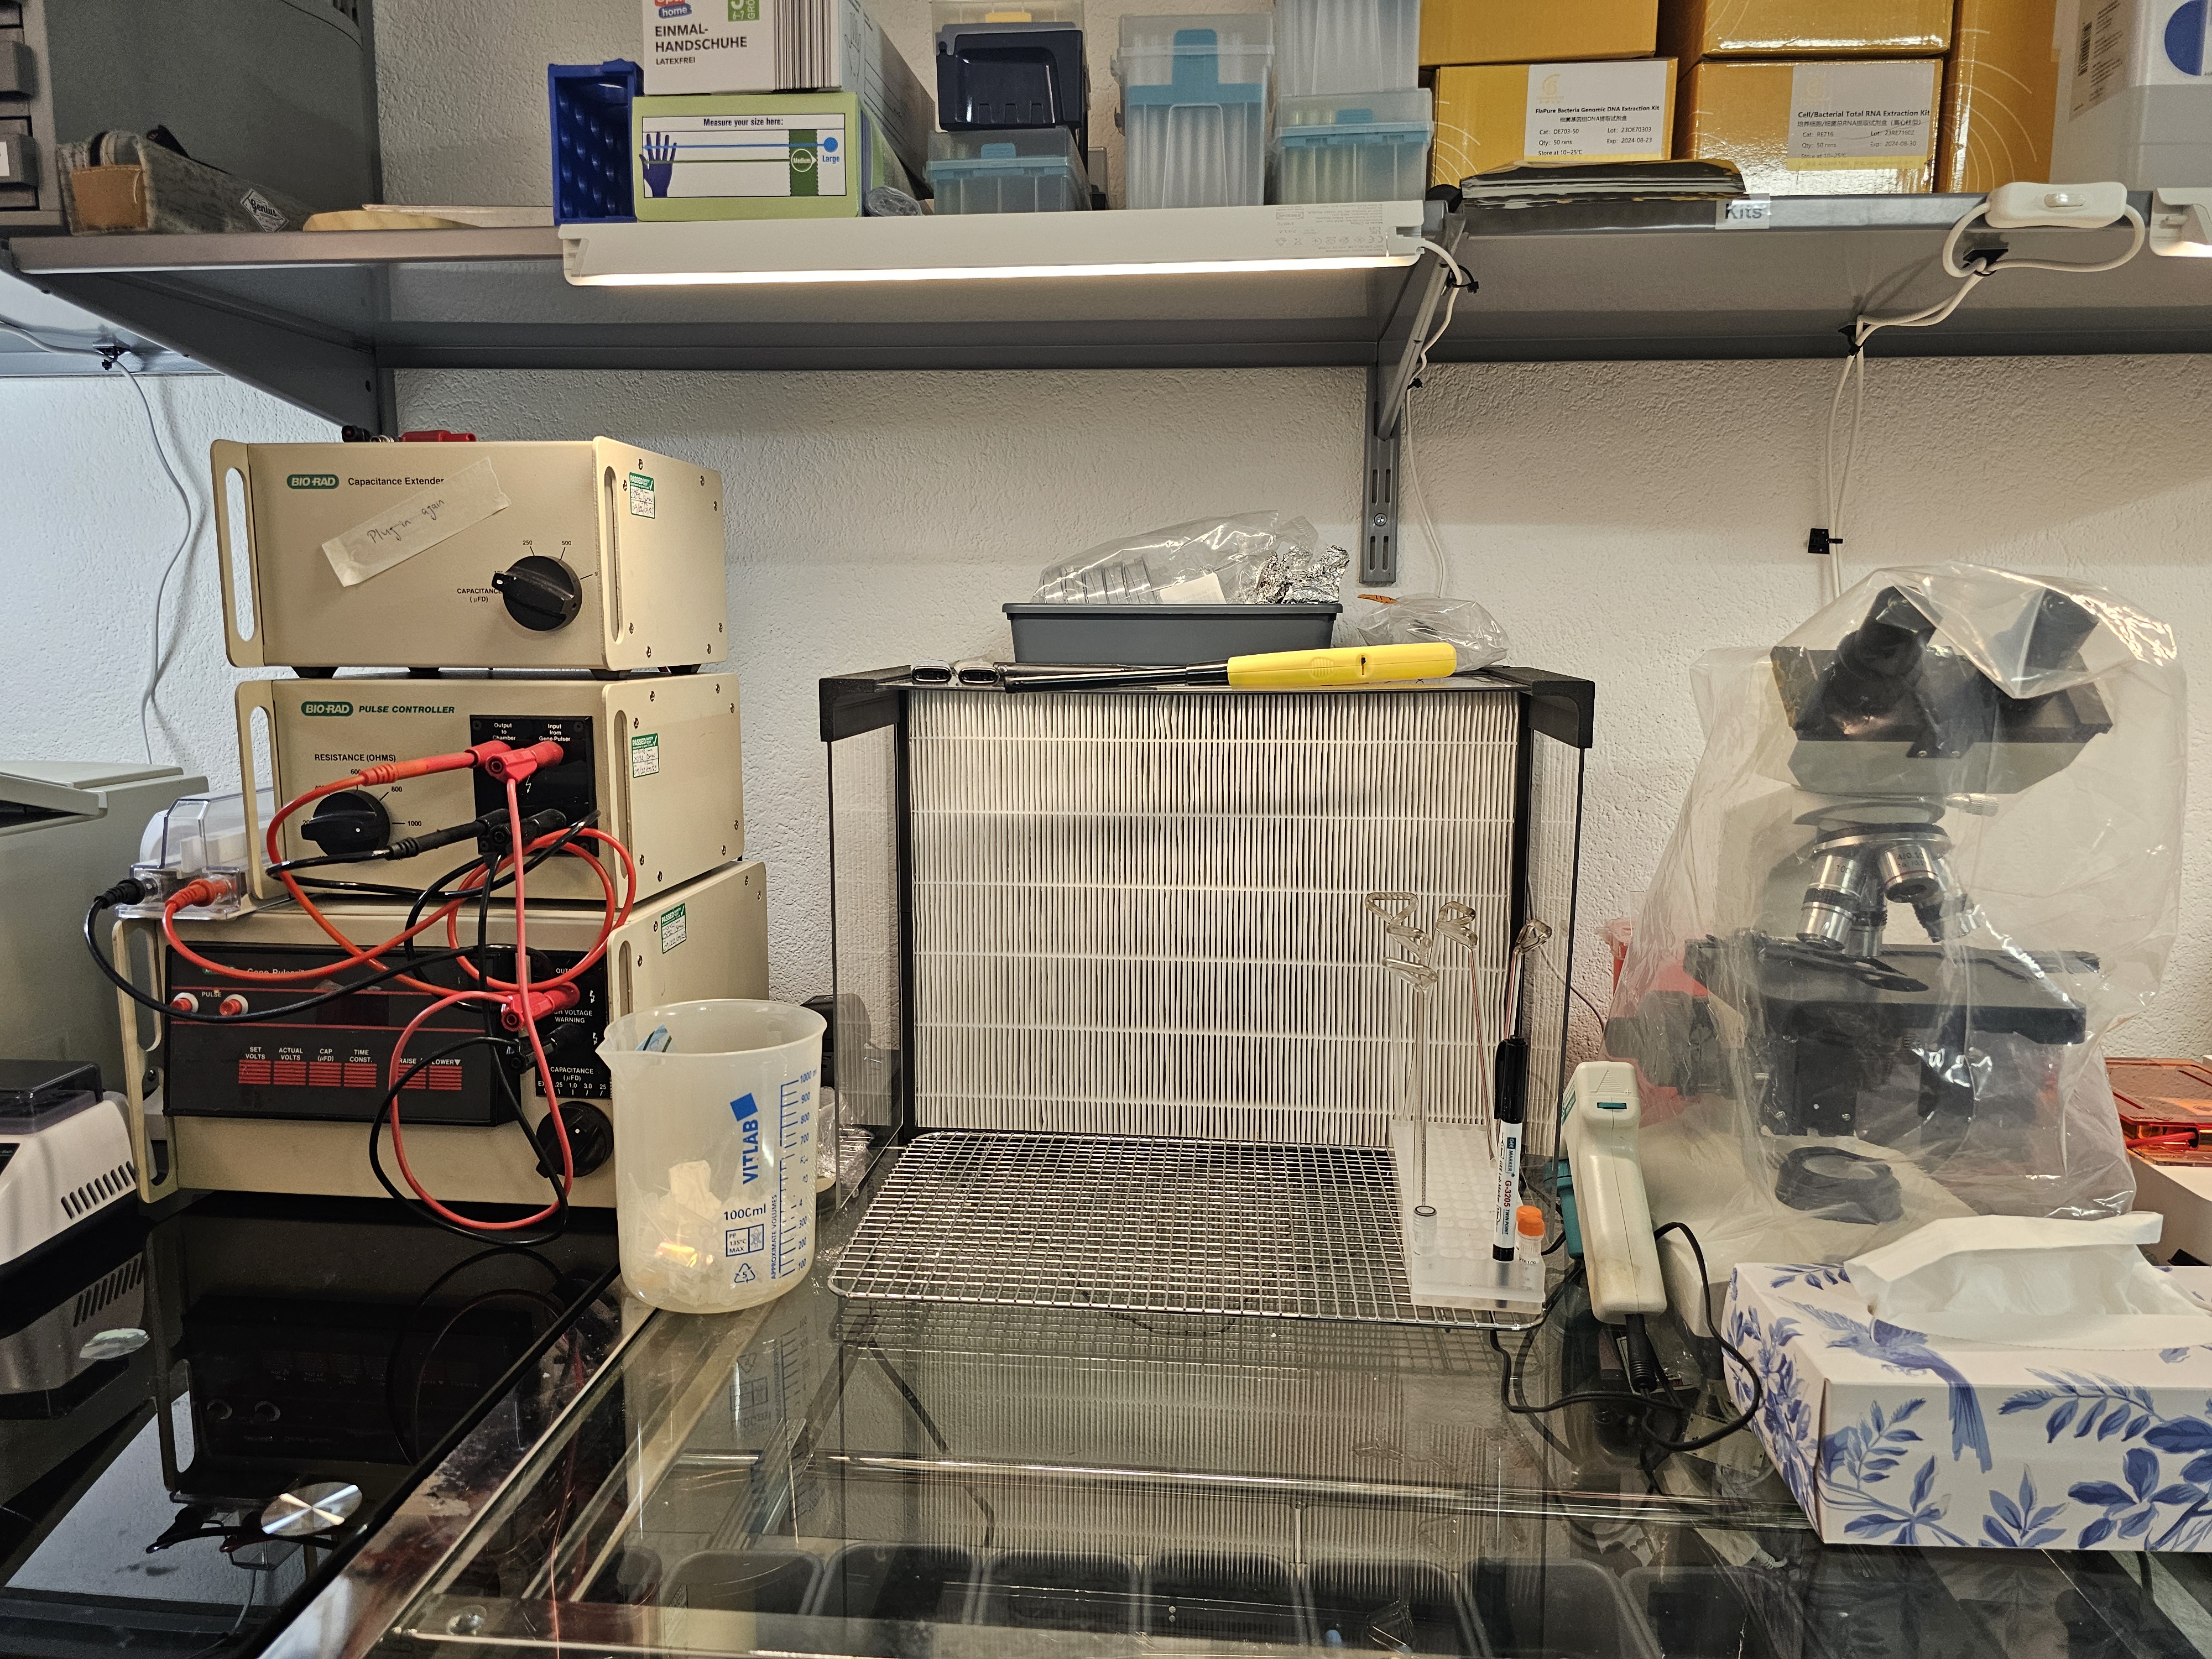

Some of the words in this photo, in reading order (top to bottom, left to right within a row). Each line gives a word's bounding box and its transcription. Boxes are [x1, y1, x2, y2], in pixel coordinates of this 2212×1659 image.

[661, 6, 687, 17] home
[733, 11, 744, 21] 6-7
[655, 23, 709, 37] EINMAL-
[655, 36, 748, 53] HANDSCHUHE
[656, 56, 696, 65] LATEXFREI
[703, 118, 732, 127] Measure
[734, 119, 749, 128] your
[766, 117, 784, 126] here:
[822, 155, 839, 164] Large
[1725, 203, 1762, 219] Kits
[291, 477, 336, 486] BIO-RAD
[348, 477, 402, 487] Capacitance
[405, 477, 445, 485] Extender
[367, 526, 402, 544] Plug
[421, 499, 445, 520] again
[305, 704, 349, 713] BIO-RAD
[359, 705, 389, 713] PULSE
[392, 705, 455, 714] CONTROLLER
[632, 737, 646, 747] PASSED
[366, 754, 397, 763] (OHMS)
[550, 1066, 594, 1074] CAPACITANCE
[800, 1071, 812, 1083] 1000
[801, 1091, 810, 1104] 900
[801, 1112, 810, 1124] 800
[800, 1133, 809, 1145] 700
[742, 1119, 759, 1185] VITLAB
[1504, 1180, 1512, 1208] G-3205
[799, 1215, 807, 1229] 300
[798, 1237, 807, 1250] 200
